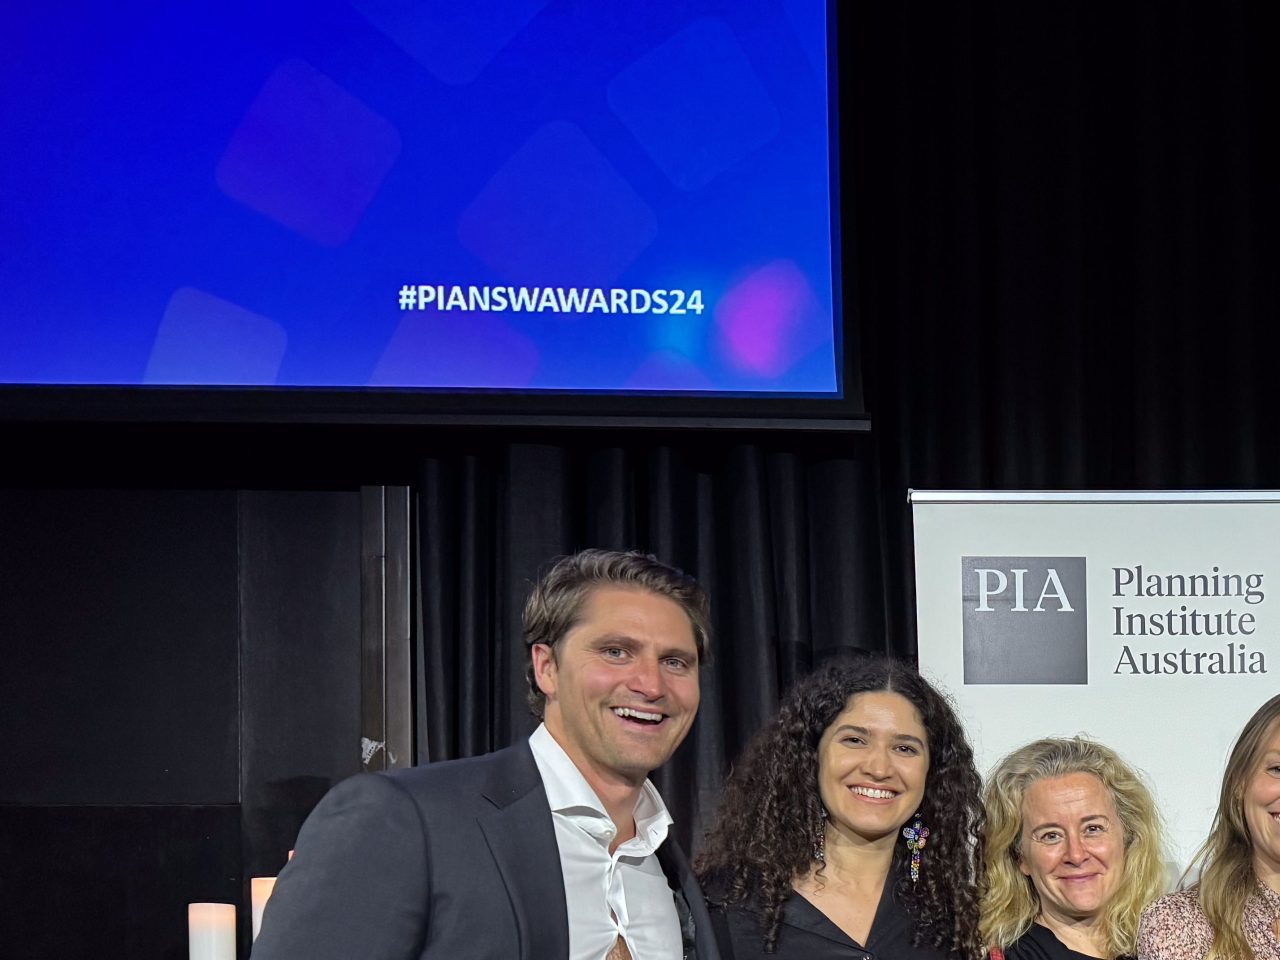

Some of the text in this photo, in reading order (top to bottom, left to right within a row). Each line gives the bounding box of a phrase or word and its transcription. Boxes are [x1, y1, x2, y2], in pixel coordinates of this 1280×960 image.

[399, 285, 704, 315] #PIANSWAWARDS24
[974, 568, 1074, 613] PIA
[1112, 565, 1265, 604] Planning
[1112, 605, 1257, 637] Institute
[1114, 643, 1268, 675] Australia
